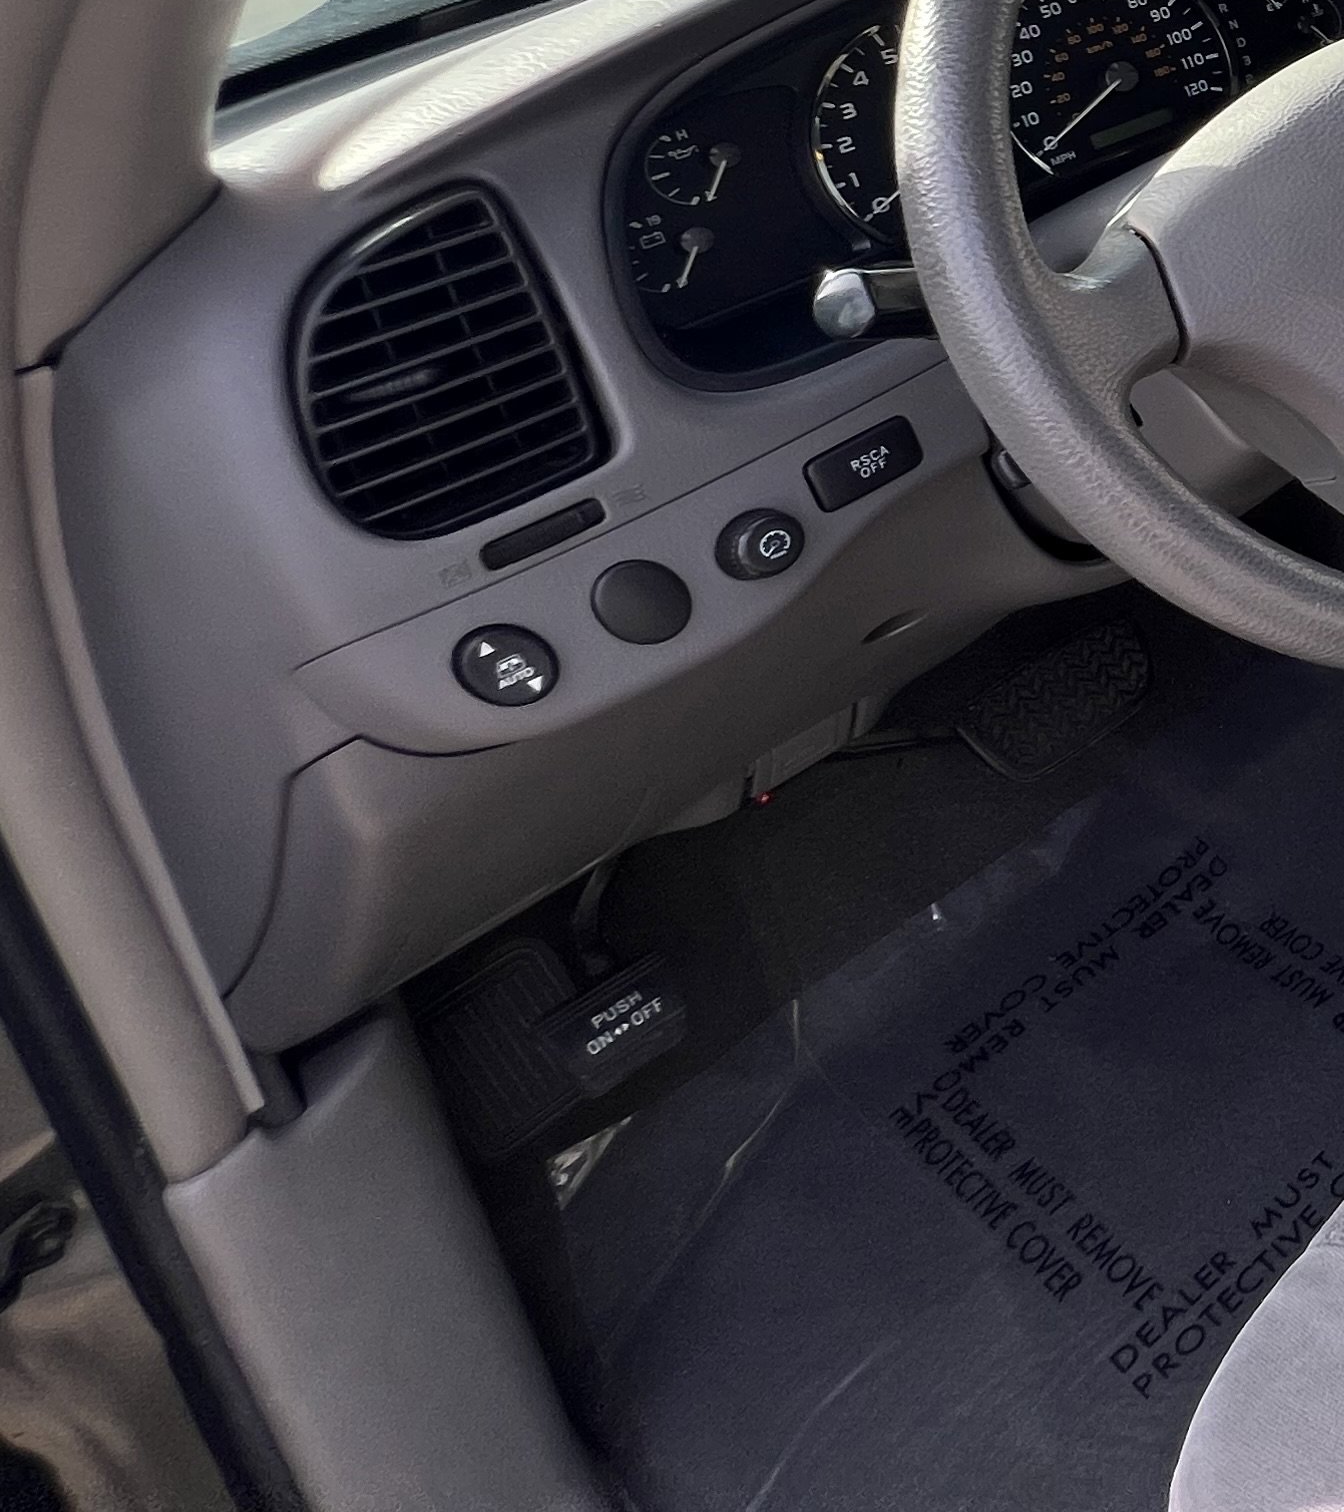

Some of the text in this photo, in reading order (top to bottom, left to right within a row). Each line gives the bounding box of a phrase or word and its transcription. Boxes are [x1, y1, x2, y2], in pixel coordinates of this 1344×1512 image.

[1039, 2, 1062, 19] 50
[1150, 6, 1171, 23] 90
[1218, 3, 1229, 13] R
[1019, 24, 1041, 40] 40
[1228, 19, 1239, 30] N
[1166, 28, 1193, 47] 100
[1236, 37, 1247, 48] D
[880, 49, 898, 65] 5
[1010, 49, 1034, 67] 30
[1181, 53, 1205, 70] 110
[853, 71, 869, 86] 4
[1010, 80, 1033, 98] 20
[1184, 79, 1209, 98] 120
[840, 103, 858, 120] 3
[1021, 111, 1040, 128] 10
[837, 137, 856, 154] 2
[1050, 150, 1077, 166] MPH
[848, 172, 860, 188] 1
[850, 445, 890, 471] RSCA
[860, 457, 887, 478] OFF
[1131, 854, 1228, 939] DEALER
[1192, 899, 1277, 971] REMOVE
[1258, 909, 1326, 962] COVER
[943, 835, 1210, 1054] PROTECTIVE COVER
[1041, 944, 1120, 1014] MUST
[1269, 963, 1335, 1009] MUST
[590, 990, 643, 1030] PUSH
[586, 996, 664, 1055] ON OFF
[942, 1089, 1165, 1311] DEALER MUST REMOVE
[902, 1117, 1083, 1303] PROTECTIVE COVER
[1110, 1250, 1238, 1374] DEALER
[1250, 1150, 1333, 1239] MUST
[1131, 1204, 1325, 1399] PROTECTIVE
